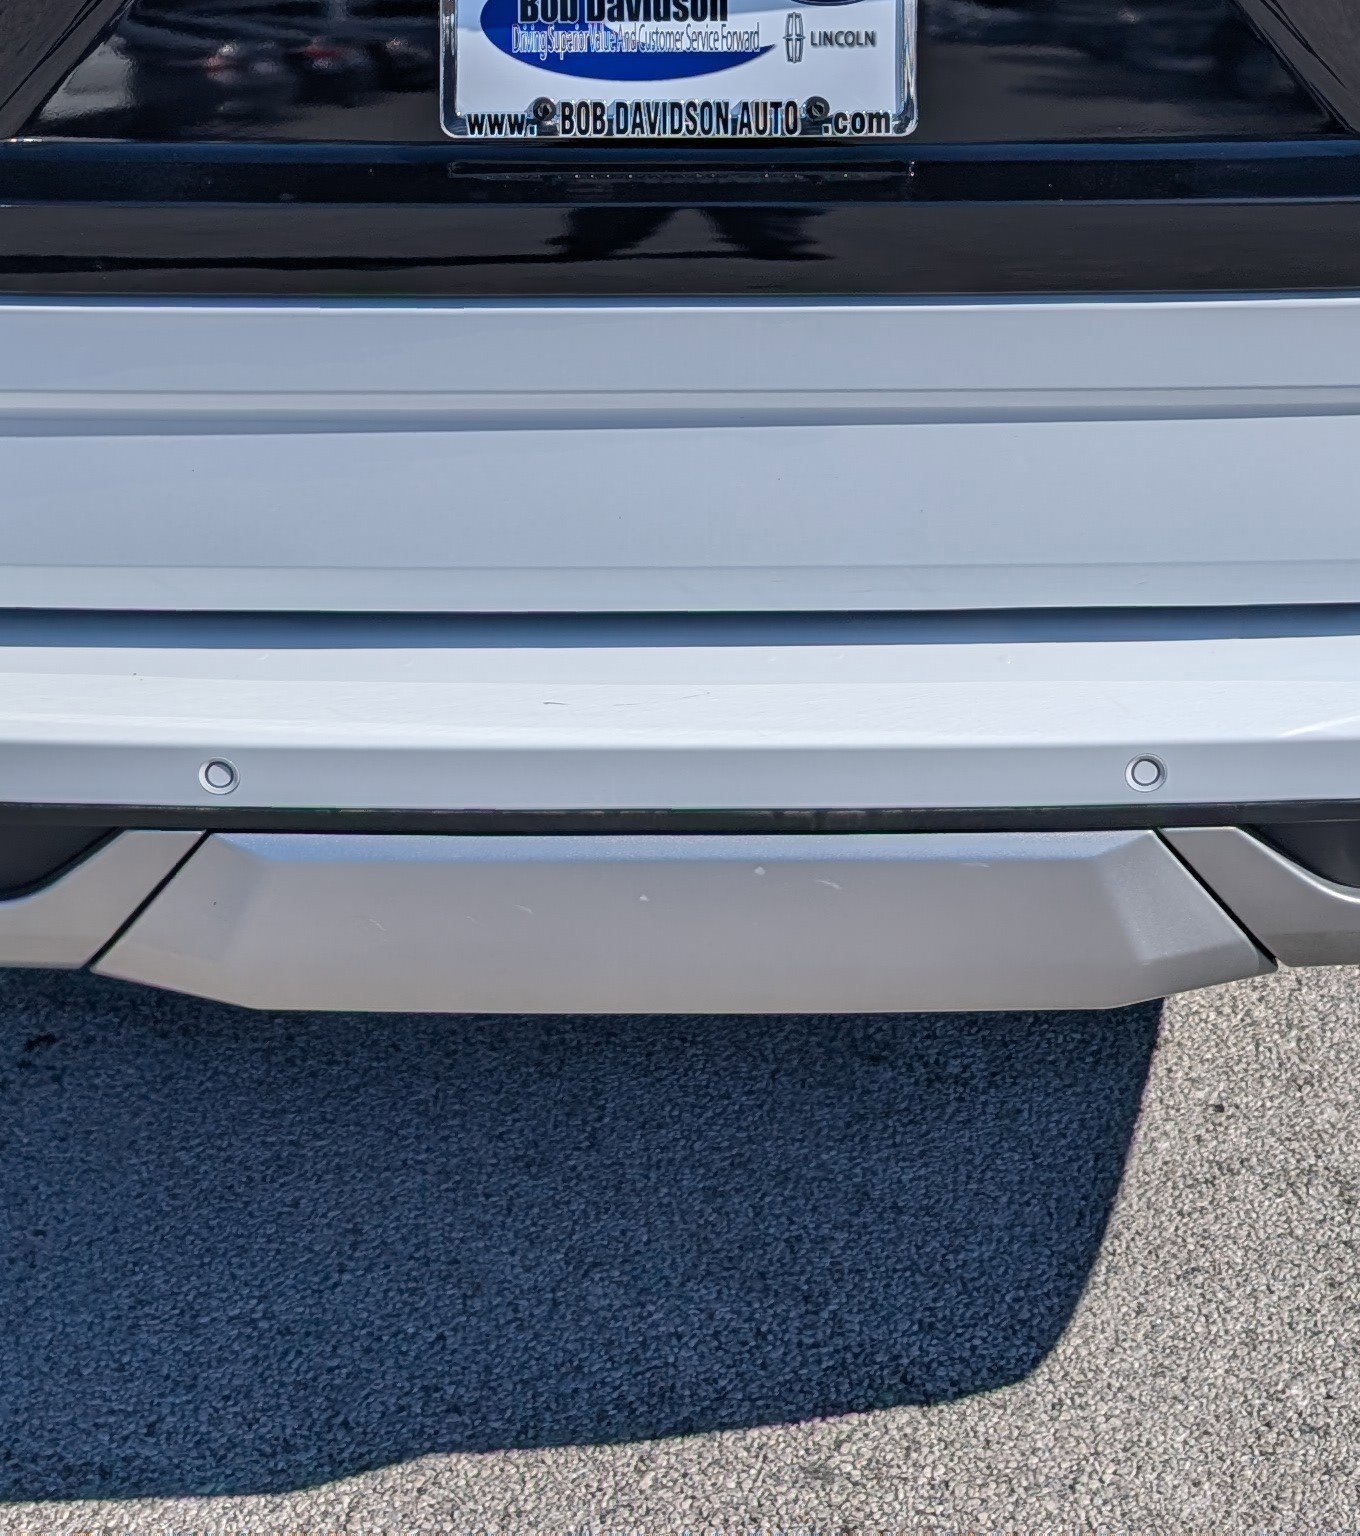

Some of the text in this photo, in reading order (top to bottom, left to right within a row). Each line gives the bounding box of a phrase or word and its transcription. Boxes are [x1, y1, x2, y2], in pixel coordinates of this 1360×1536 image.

[512, 22, 760, 60] Driving Superior Value And Customer Service Forward
[810, 30, 877, 47] LINCOLN
[559, 99, 608, 136] BOB
[613, 98, 732, 136] DAVIDSON
[736, 98, 802, 136] AUTO
